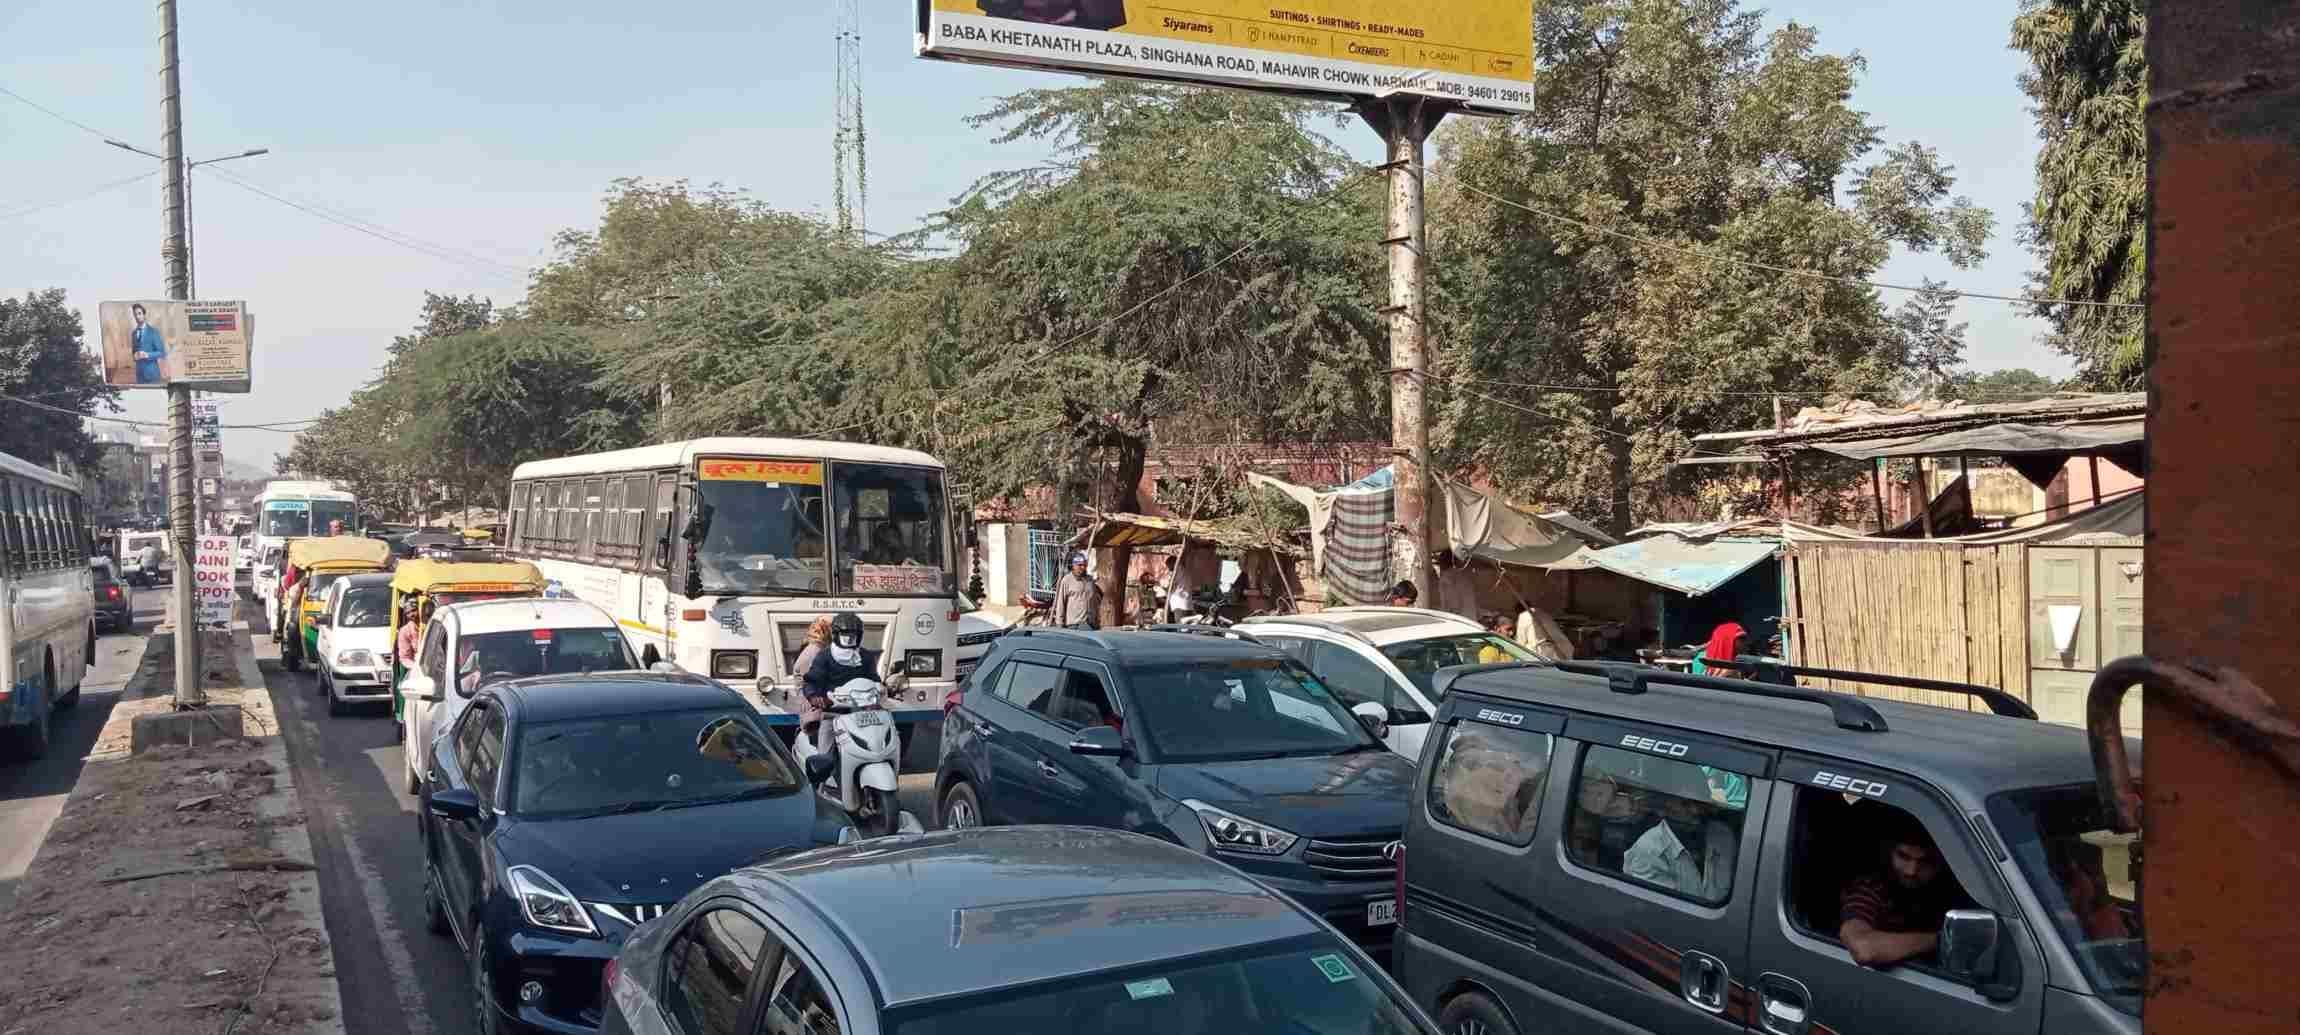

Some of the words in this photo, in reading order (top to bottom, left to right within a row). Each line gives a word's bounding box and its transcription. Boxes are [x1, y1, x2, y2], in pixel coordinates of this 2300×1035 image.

[1162, 16, 1215, 34] Siyarams
[1269, 9, 1309, 24] SUITINGS
[1316, 15, 1361, 32] SHIRTINGS
[1367, 22, 1425, 39] READY-MADES
[942, 23, 987, 42] BABA
[990, 29, 1082, 53] KHETANATH
[1085, 40, 1137, 61] PLAZA,
[1140, 46, 1213, 68] SINGHANA
[1217, 55, 1258, 73] ROAD,
[1262, 57, 1320, 80] MAHAVIR
[1322, 64, 1370, 87] CHOWK
[1436, 80, 1465, 97] MOB:
[1467, 86, 1498, 101] 94601
[1501, 89, 1531, 105] 29015
[203, 539, 229, 551] O.P.
[193, 571, 229, 583] OOK
[1477, 709, 1525, 726] EECO
[1620, 734, 1689, 757] EECO
[1812, 771, 1888, 798] EECO
